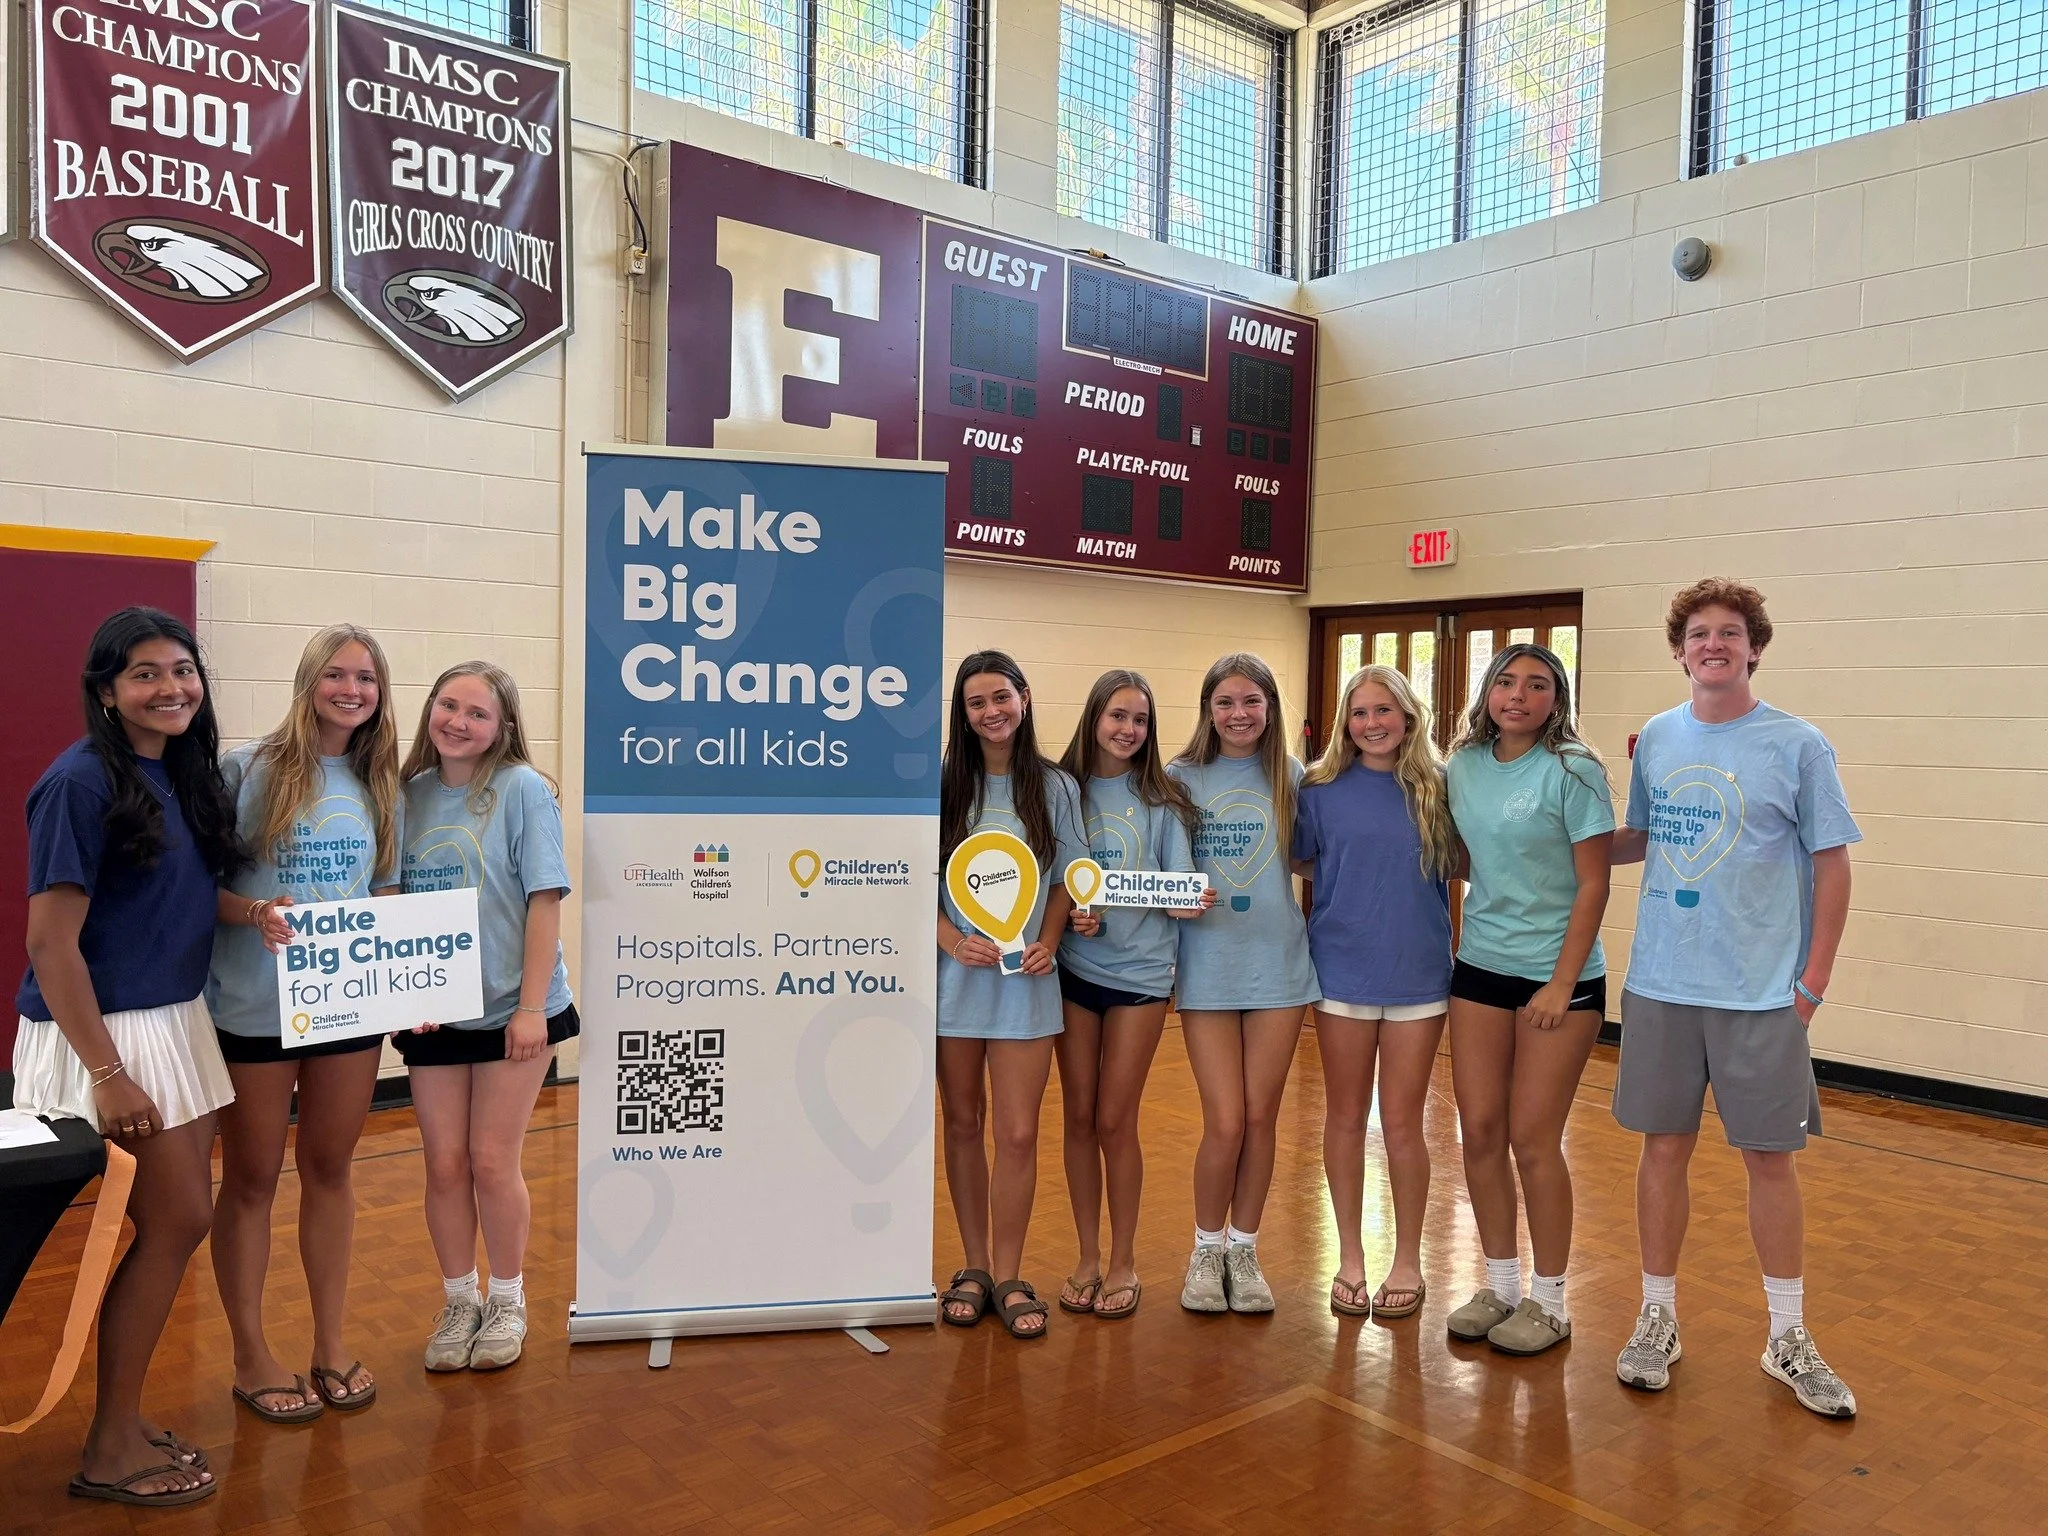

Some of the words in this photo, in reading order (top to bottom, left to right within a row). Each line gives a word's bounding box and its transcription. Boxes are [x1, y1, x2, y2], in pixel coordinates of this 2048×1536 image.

[100, 0, 262, 42] MSC
[52, 5, 302, 96] CHAMPIONS
[383, 37, 520, 106] IMSC
[110, 73, 252, 155] 2001
[345, 78, 553, 157] CHAMPIONS
[390, 138, 515, 208] 2017
[53, 138, 304, 247] BASEBALL
[347, 198, 402, 256] GIRLS
[406, 209, 466, 254] CROSS
[470, 221, 555, 293] COUNTRY
[943, 240, 1048, 292] GUEST
[713, 215, 881, 459] E
[1228, 315, 1298, 356] HOME
[1114, 358, 1161, 374] ELECTRO-MECH
[1064, 382, 1145, 418] PERIOD
[962, 427, 1023, 455] FOULS
[1076, 447, 1190, 482] PLAYER-FOUL
[1234, 474, 1280, 496] FOULS
[623, 488, 821, 554] Make
[956, 522, 1026, 548] POINTS
[1076, 537, 1137, 560] MATCH
[1413, 531, 1448, 565] EXIT
[1228, 555, 1281, 576] POINTS
[623, 563, 737, 640] Big
[621, 643, 908, 721] Change
[619, 726, 681, 764] for
[696, 727, 746, 765] all
[763, 729, 849, 767] kids
[1651, 786, 1669, 799] his
[1233, 833, 1252, 847] Up
[1662, 830, 1696, 846] Next
[1686, 819, 1705, 835] Up
[334, 852, 357, 869] Up
[1213, 845, 1244, 857] Next
[277, 870, 307, 884] the
[311, 868, 348, 883] Next
[401, 864, 464, 880] eneration
[693, 868, 730, 878] Wolfson
[824, 859, 909, 874] Children's
[690, 879, 732, 889] Children's
[824, 876, 863, 886] Miracle
[1104, 873, 1202, 894] Children's
[693, 890, 729, 902] Hospital
[1104, 893, 1149, 905] Miracle
[1151, 895, 1201, 907] Network
[284, 907, 376, 937] Make
[286, 942, 340, 975] Big
[348, 932, 473, 964] Change
[616, 933, 763, 965] Hospitals.
[773, 933, 899, 958] Partners.
[288, 980, 333, 1007] for
[343, 969, 378, 999] all
[388, 963, 447, 993] kids
[616, 974, 766, 1005] Programs.
[775, 970, 836, 996] And
[845, 970, 905, 994] You.
[312, 1010, 359, 1025] Children's
[312, 1023, 334, 1031] Miracle
[612, 1147, 653, 1162] Who
[659, 1146, 687, 1160] We
[692, 1145, 722, 1159] Are
